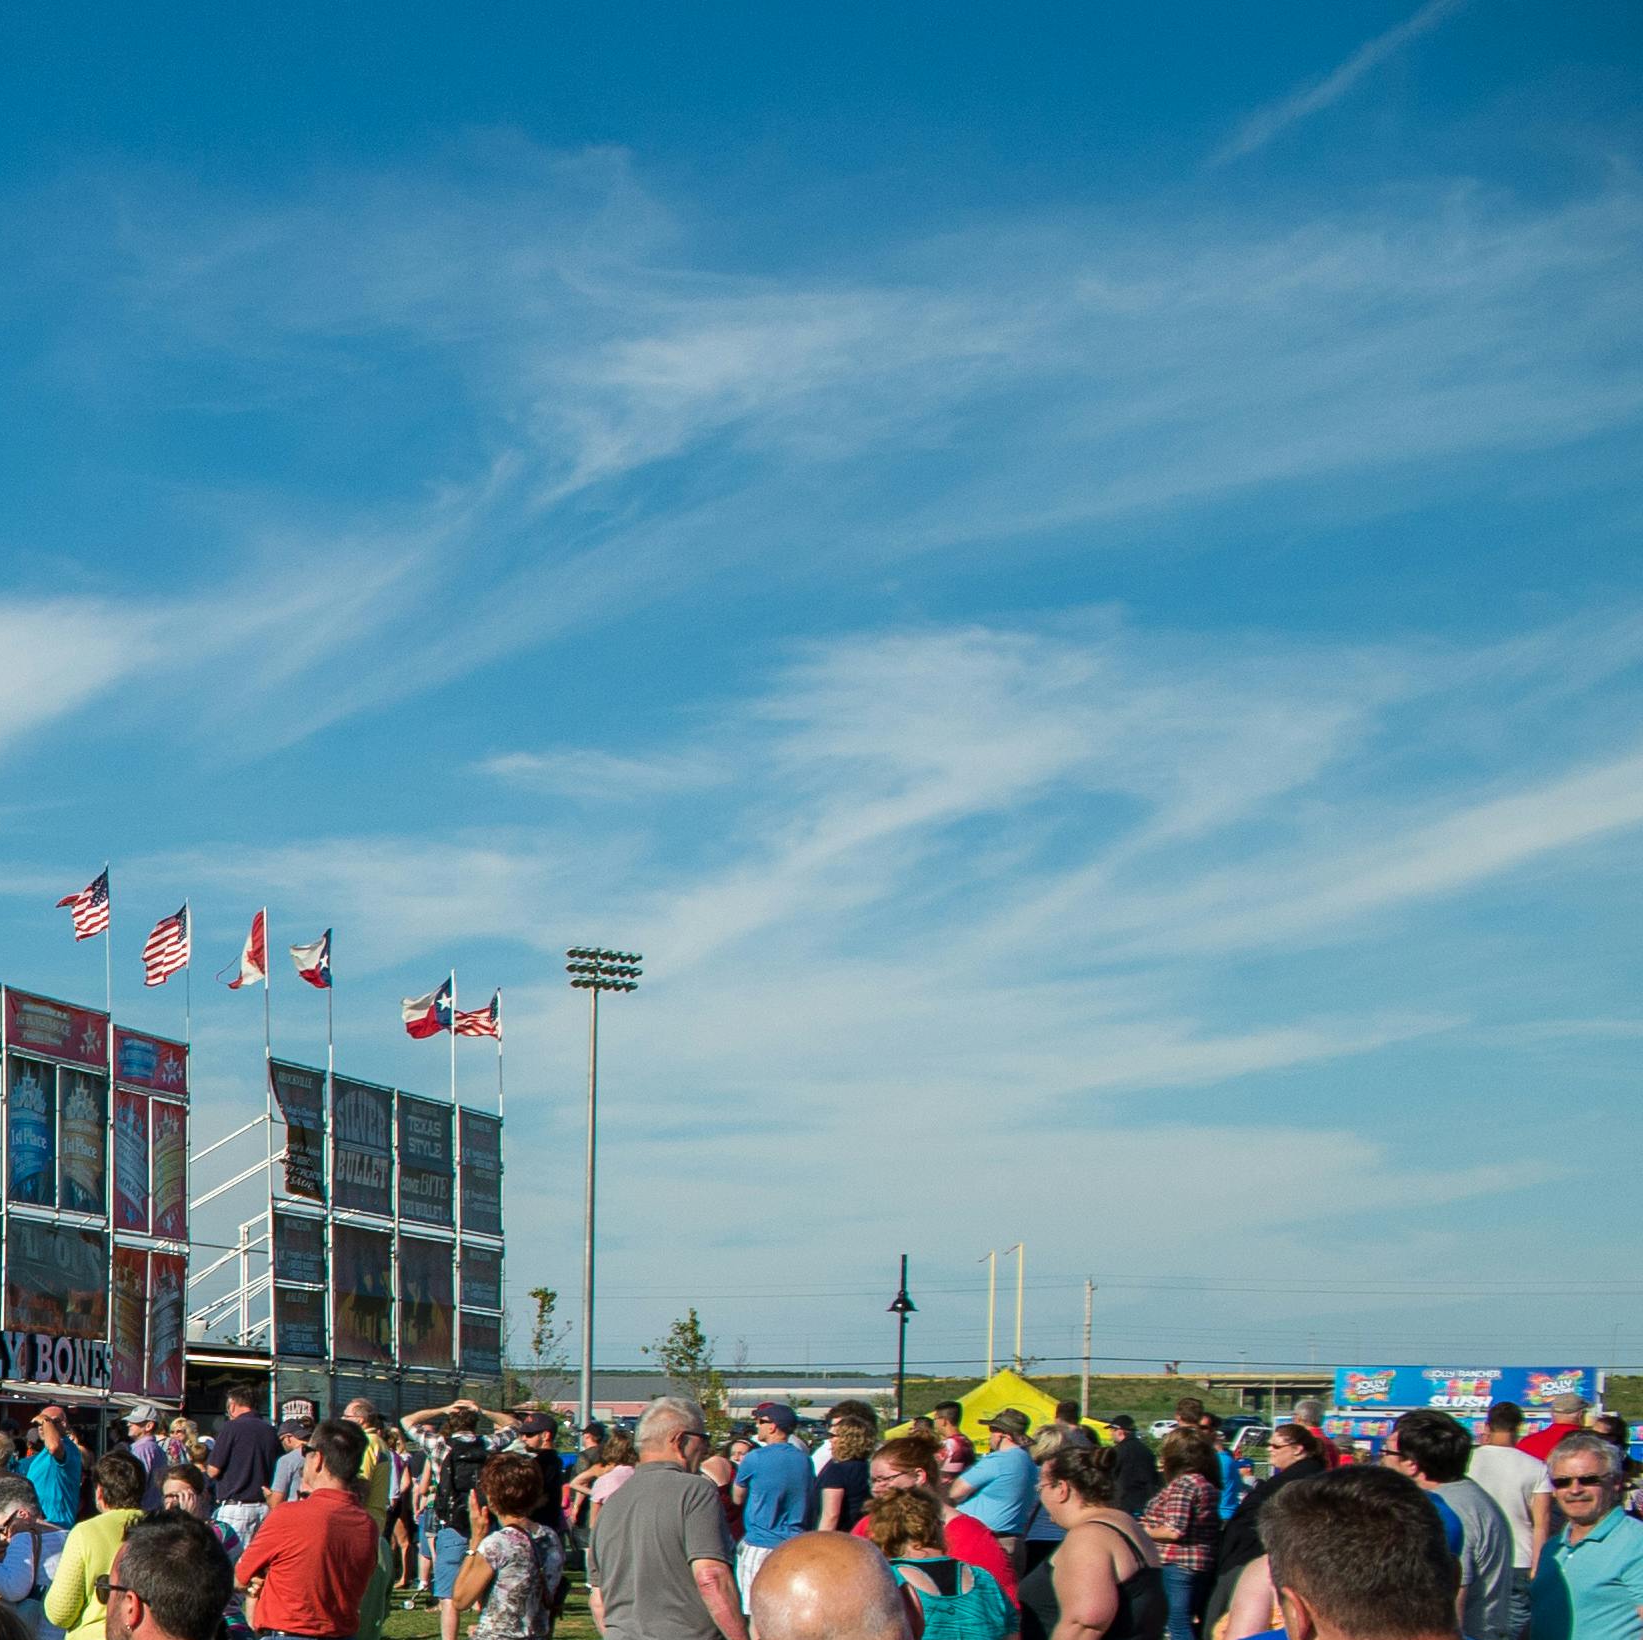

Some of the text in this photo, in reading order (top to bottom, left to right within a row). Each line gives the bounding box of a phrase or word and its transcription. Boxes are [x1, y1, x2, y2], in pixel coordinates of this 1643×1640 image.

[336, 1149, 389, 1189] BULLET
[35, 1333, 114, 1389] BONES
[1428, 1394, 1494, 1408] SLUSH
